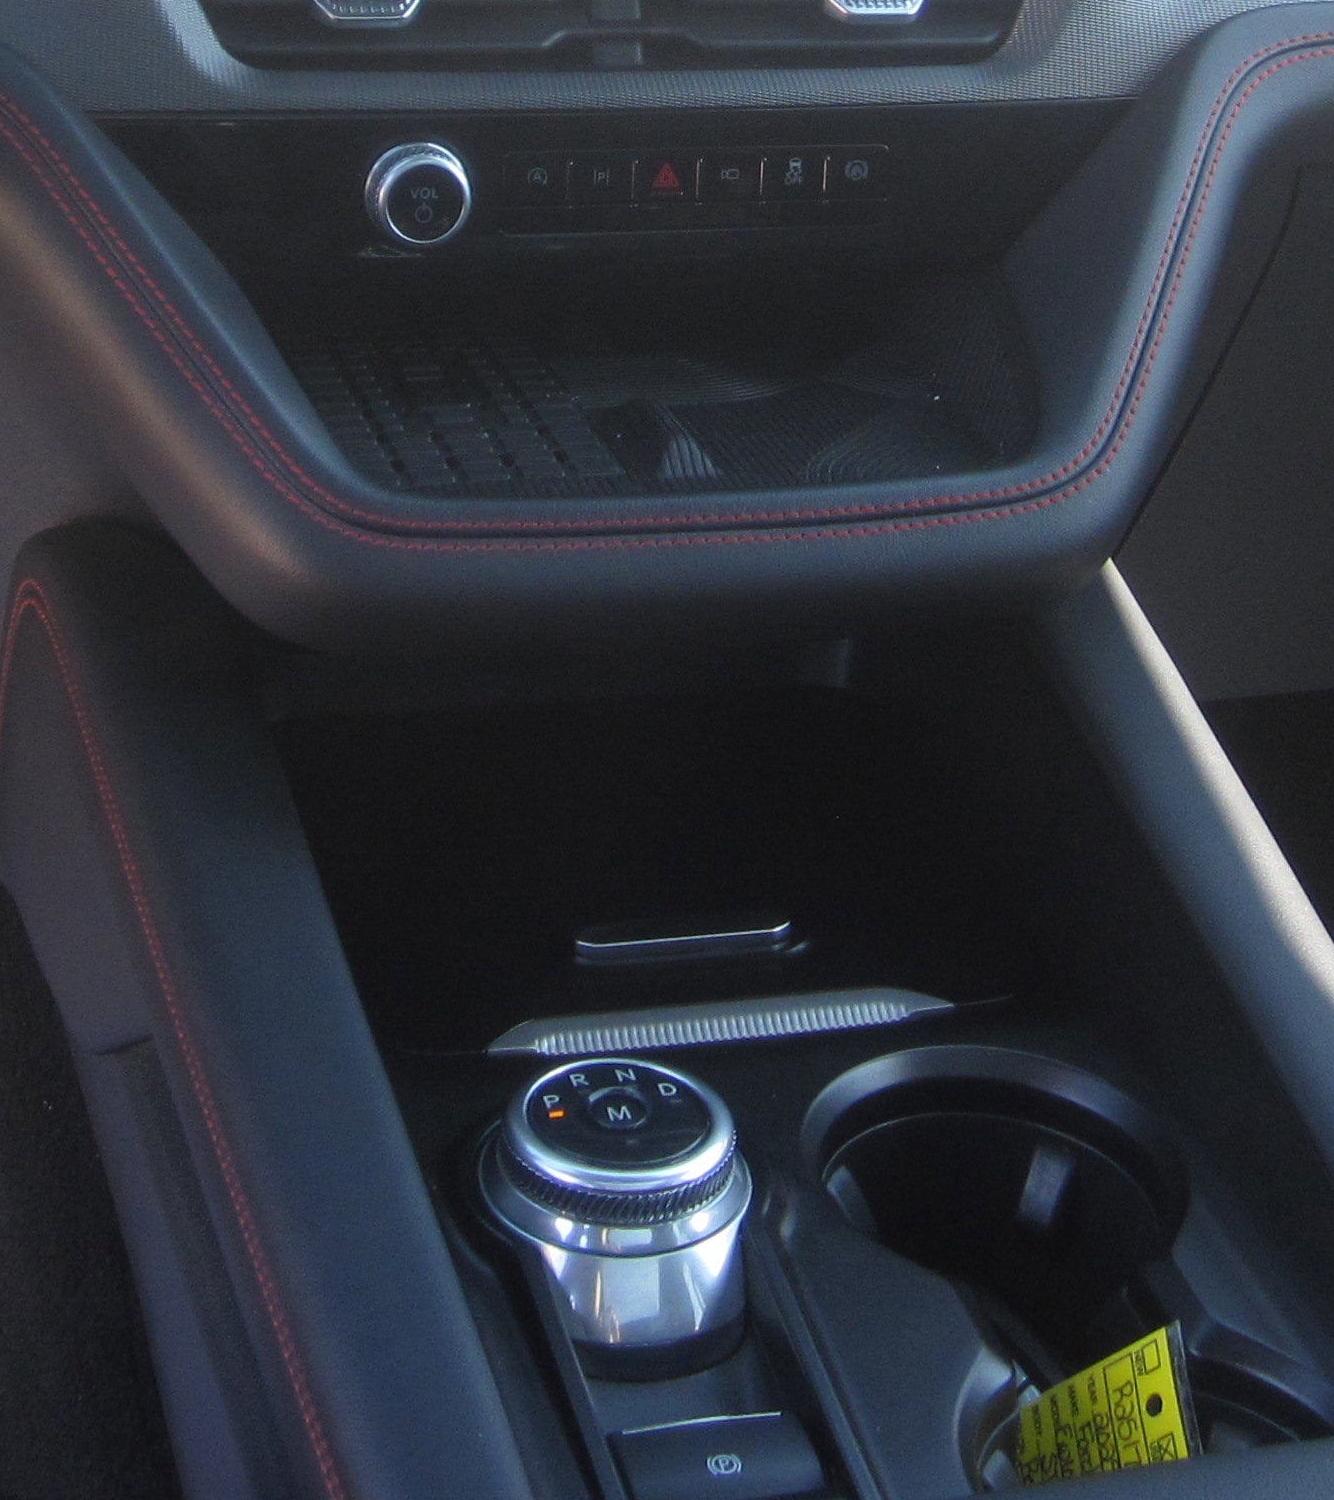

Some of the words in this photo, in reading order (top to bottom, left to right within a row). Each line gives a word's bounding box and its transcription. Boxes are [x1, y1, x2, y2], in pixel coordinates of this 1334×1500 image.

[410, 187, 439, 200] VOL
[543, 1094, 560, 1110] P
[569, 1073, 589, 1088] R
[615, 1068, 636, 1083] N
[657, 1083, 677, 1097] D
[607, 1105, 632, 1121] M
